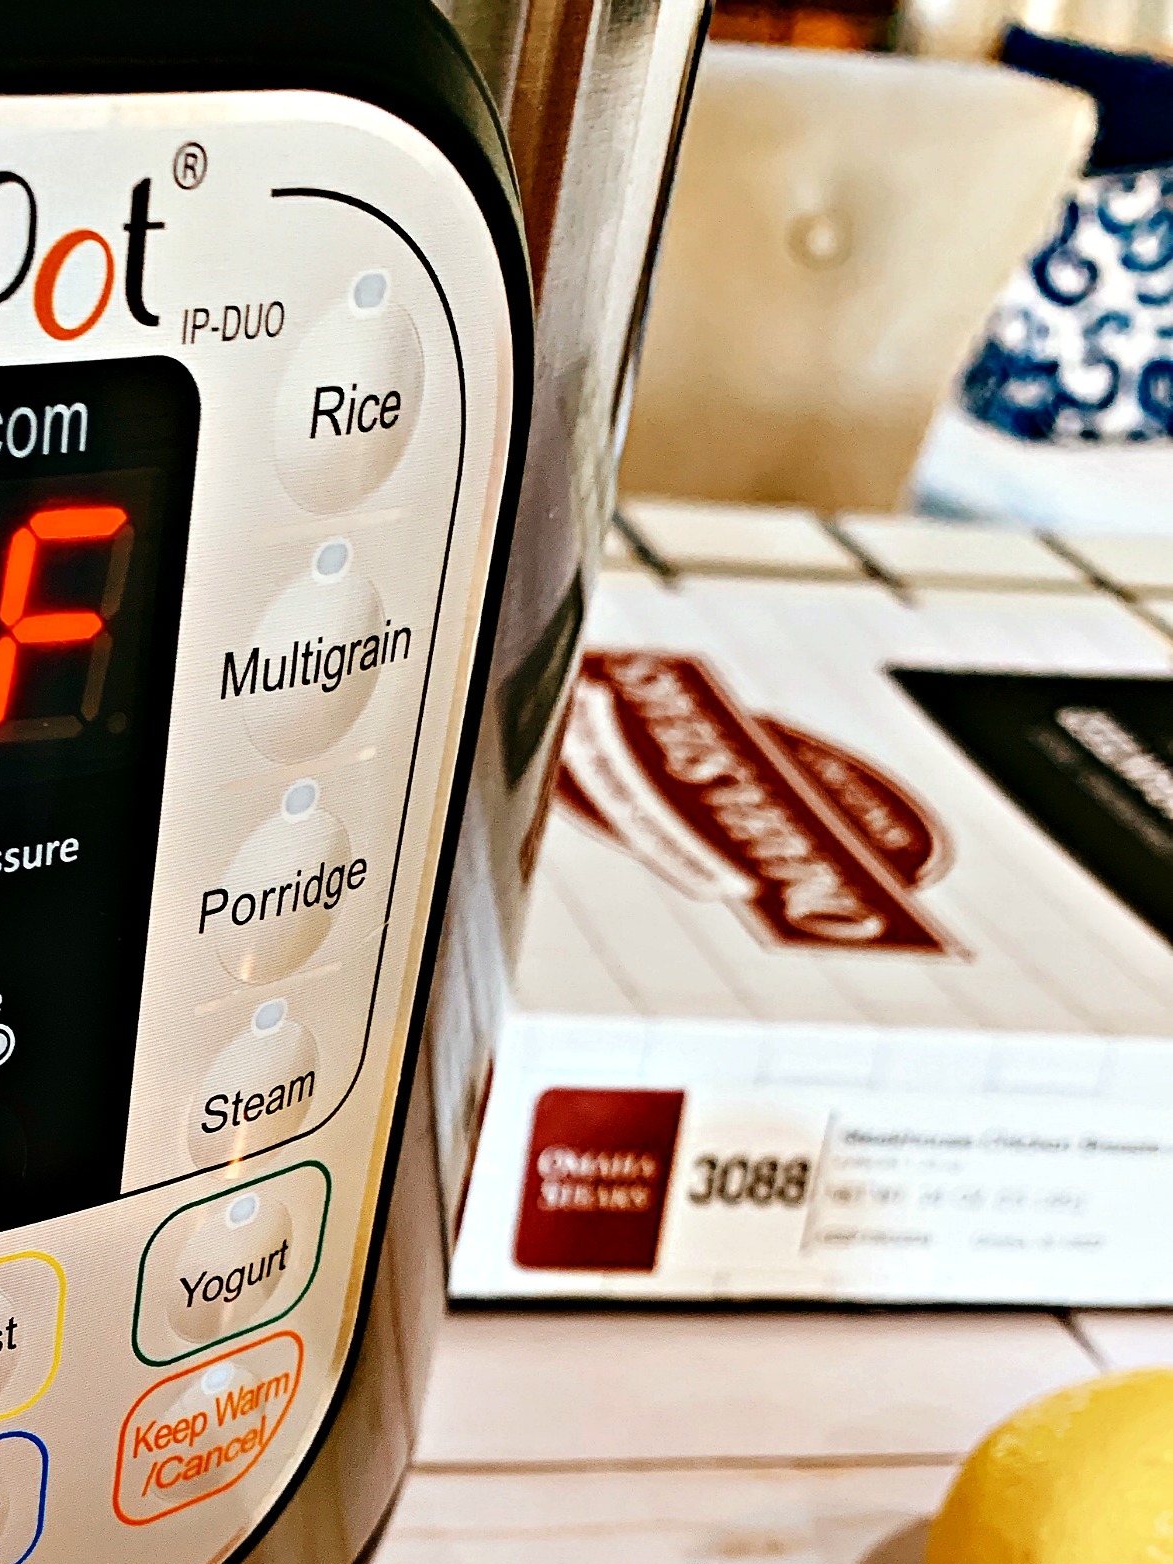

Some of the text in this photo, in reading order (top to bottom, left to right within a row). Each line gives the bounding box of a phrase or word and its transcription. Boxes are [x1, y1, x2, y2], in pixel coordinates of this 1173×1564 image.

[180, 301, 285, 345] IP-DUO
[310, 383, 402, 439] Rice
[219, 620, 413, 701] Multigrain
[197, 854, 369, 935] Porridge
[201, 1067, 317, 1135] Steam
[690, 1155, 812, 1207] 3088
[179, 1240, 289, 1308] Yogurt
[133, 1371, 292, 1457] Keep Warm
[141, 1416, 268, 1495] /Cancel
